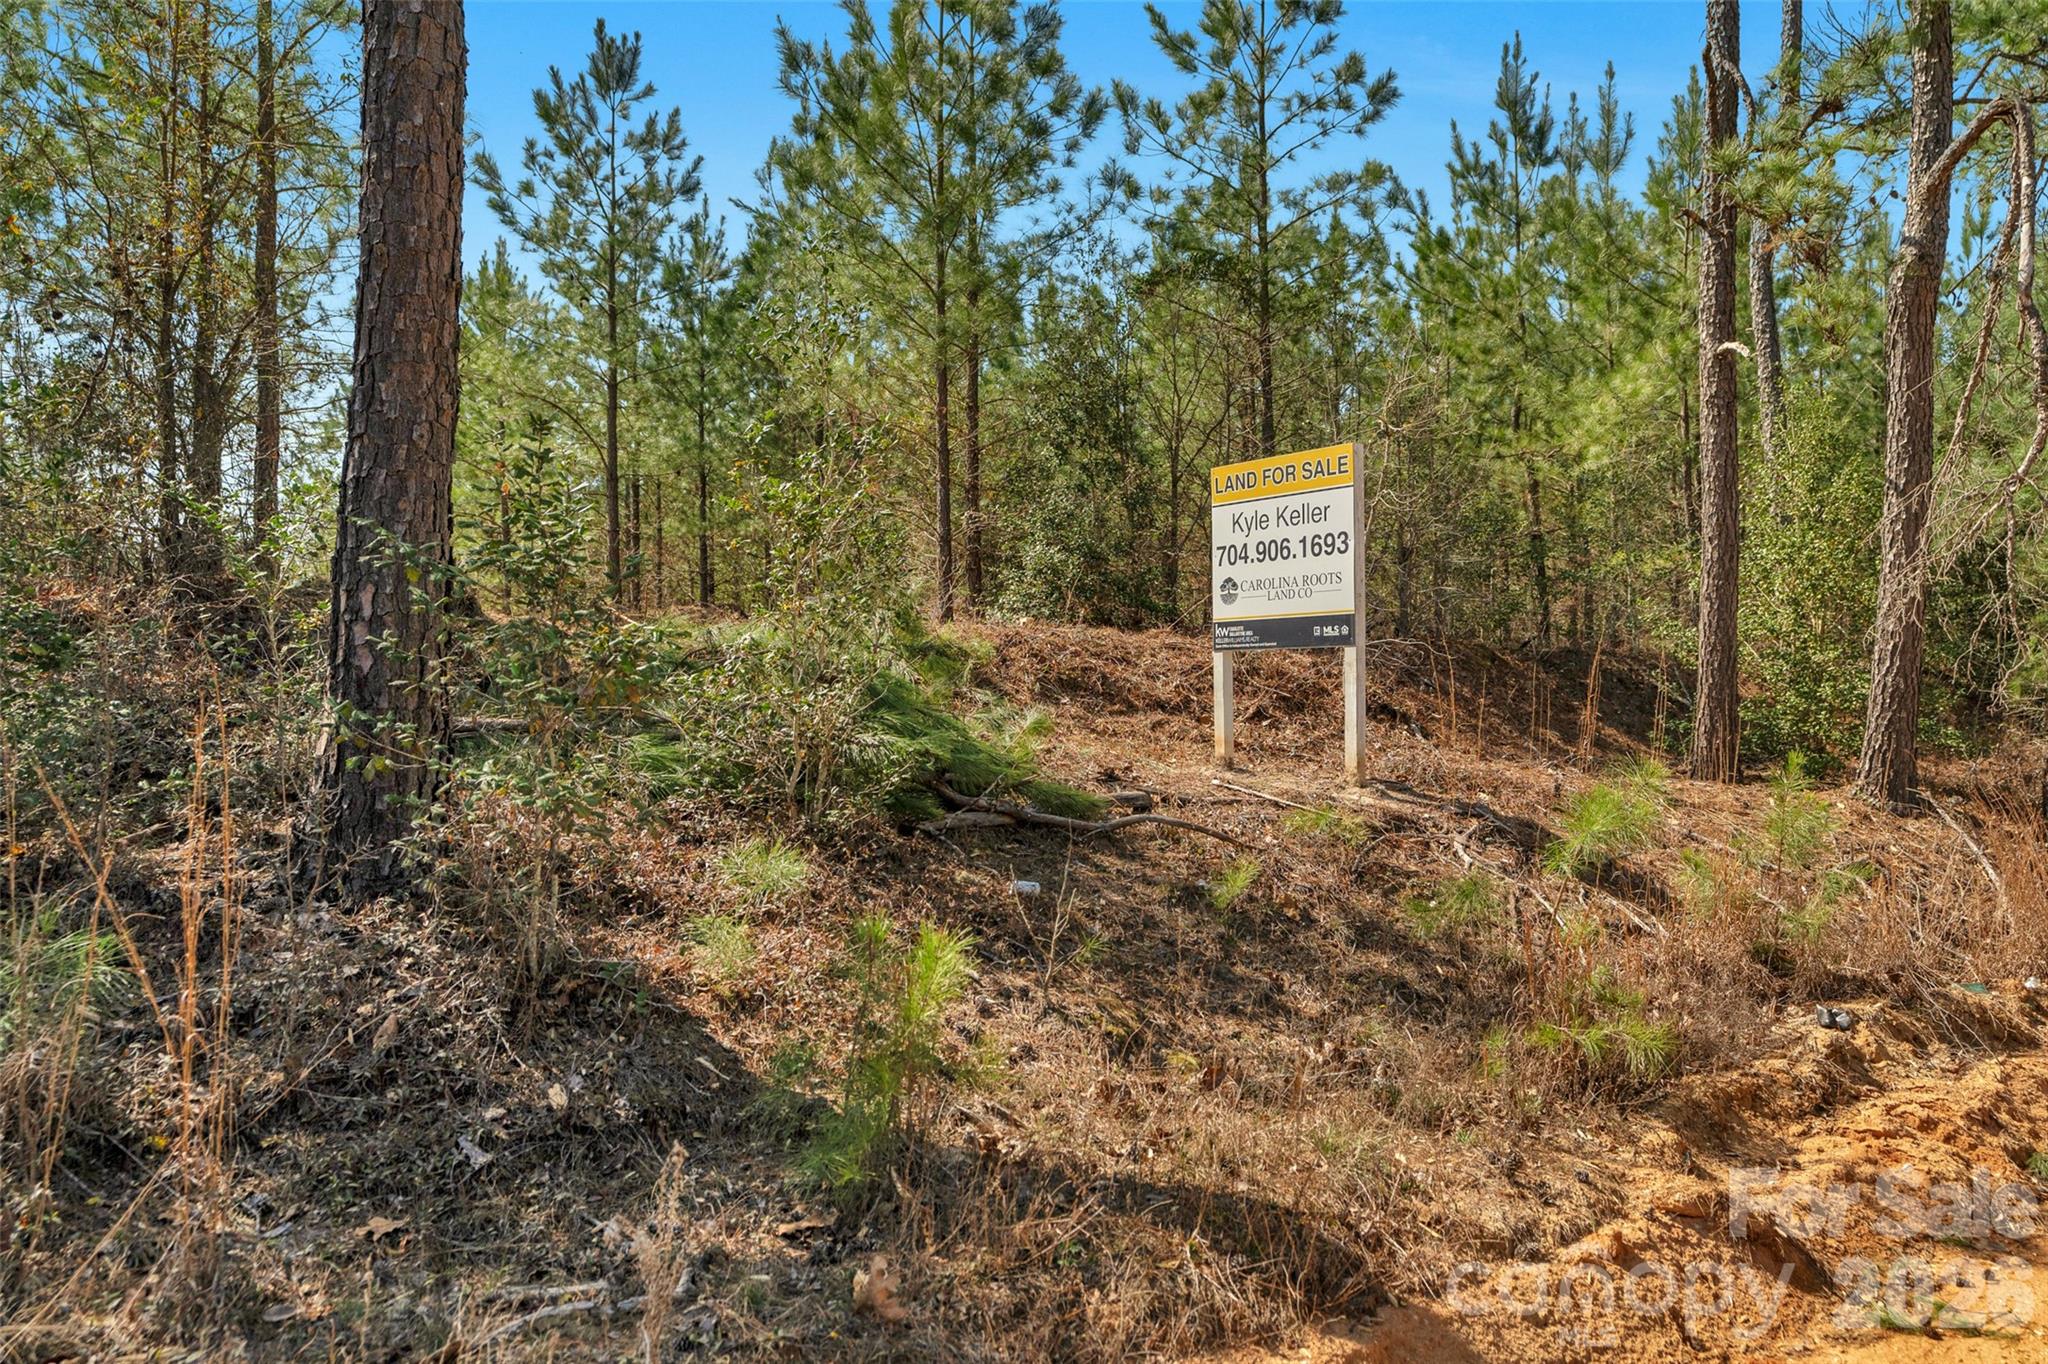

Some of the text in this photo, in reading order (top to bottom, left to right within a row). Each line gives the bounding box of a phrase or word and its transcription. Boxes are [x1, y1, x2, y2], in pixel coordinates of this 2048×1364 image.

[1215, 455, 1349, 494] LAND FOR SALE
[1232, 502, 1330, 538] Kyle Keller
[1216, 531, 1350, 567] 704.906.1693
[1240, 571, 1343, 592] CAROLINA ROOTS
[1267, 587, 1313, 601] LAND CO
[1323, 625, 1340, 634] MLS
